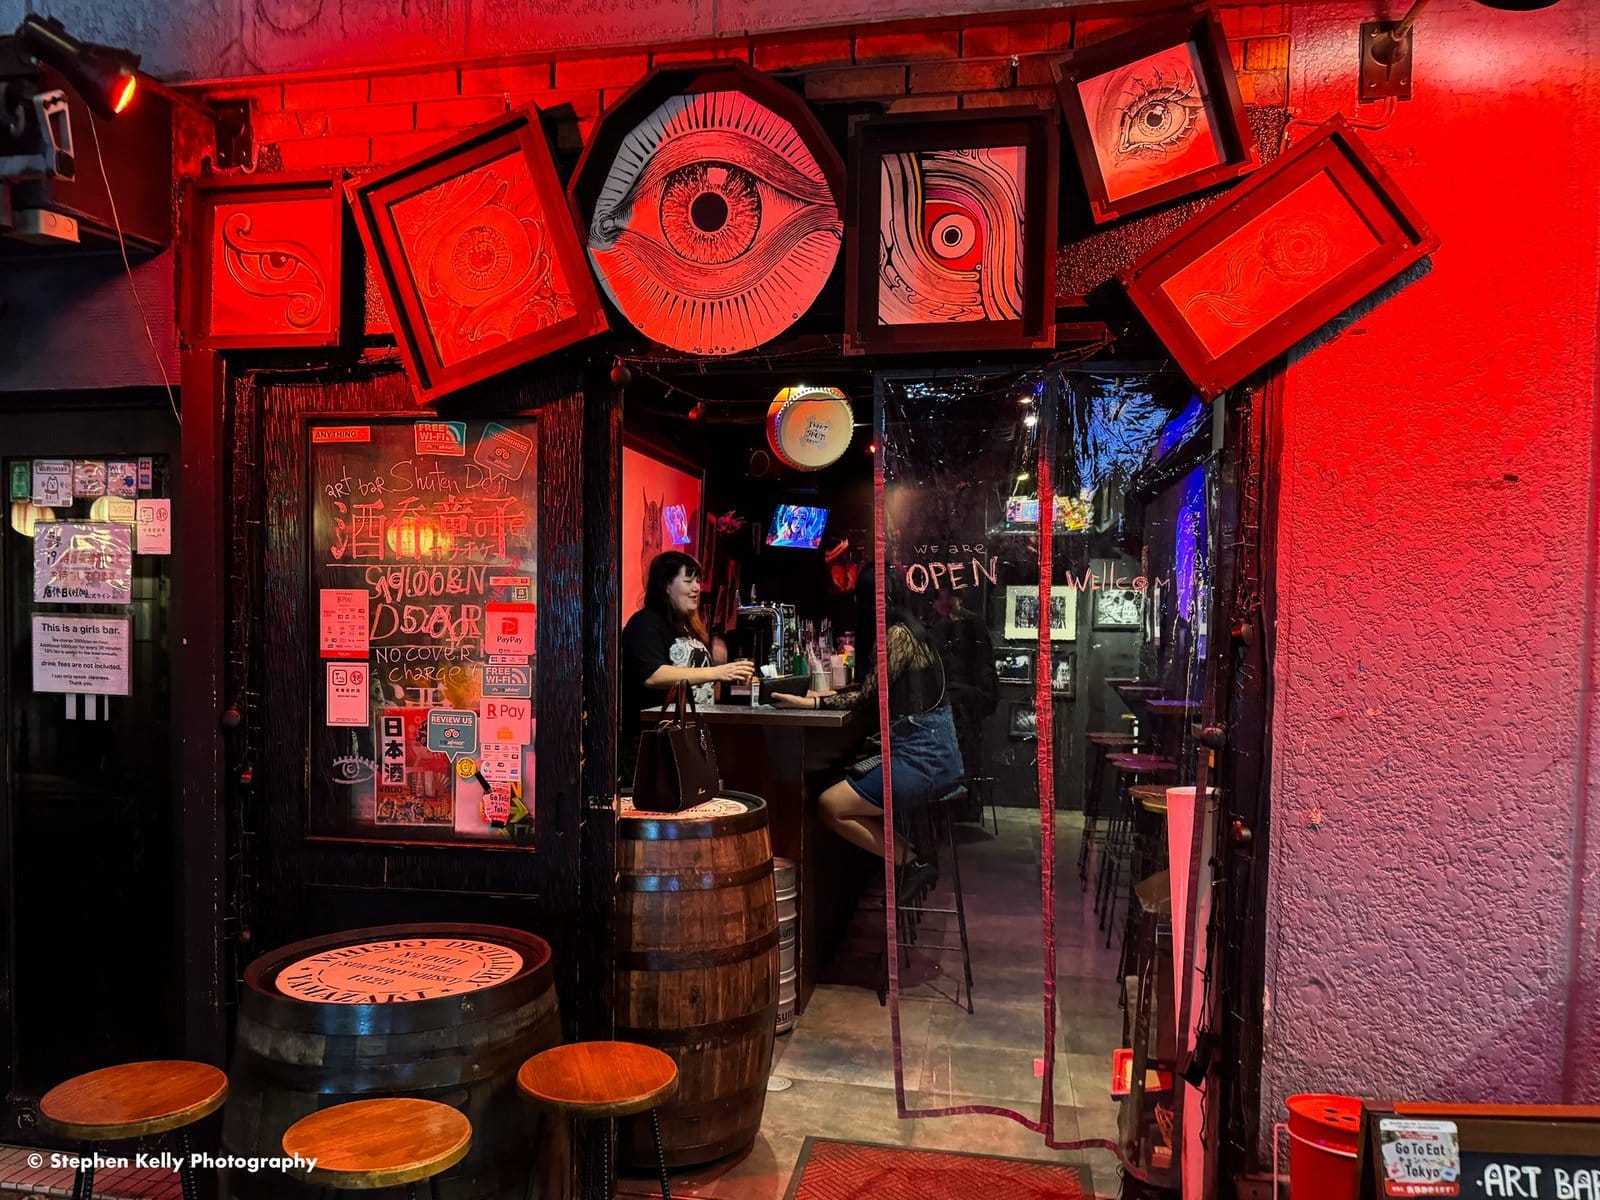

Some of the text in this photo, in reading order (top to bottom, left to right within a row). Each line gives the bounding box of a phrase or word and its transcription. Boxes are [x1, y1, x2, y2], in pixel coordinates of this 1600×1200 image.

[419, 423, 445, 432] FREE
[315, 430, 357, 439] ANYTHING
[419, 432, 446, 441] WI-FI
[906, 556, 998, 594] OPEN
[42, 623, 60, 632] This
[62, 624, 70, 632] is
[80, 625, 100, 634] girls
[102, 626, 120, 635] bar.
[496, 635, 523, 645] PayPay
[375, 647, 401, 664] NO
[485, 667, 511, 675] FREE
[485, 675, 511, 684] WI-FI
[486, 703, 525, 720] R Pay
[431, 716, 461, 724] REVIEW
[384, 717, 404, 783] 日本酒
[311, 940, 518, 987] WHISKY DISTILLERY
[340, 960, 407, 976] SUNTORY
[346, 975, 395, 986] 1923
[1395, 1142, 1446, 1156] Go To Eat
[1405, 1164, 1441, 1180] Tokyo
[1483, 1163, 1542, 1198] ART
